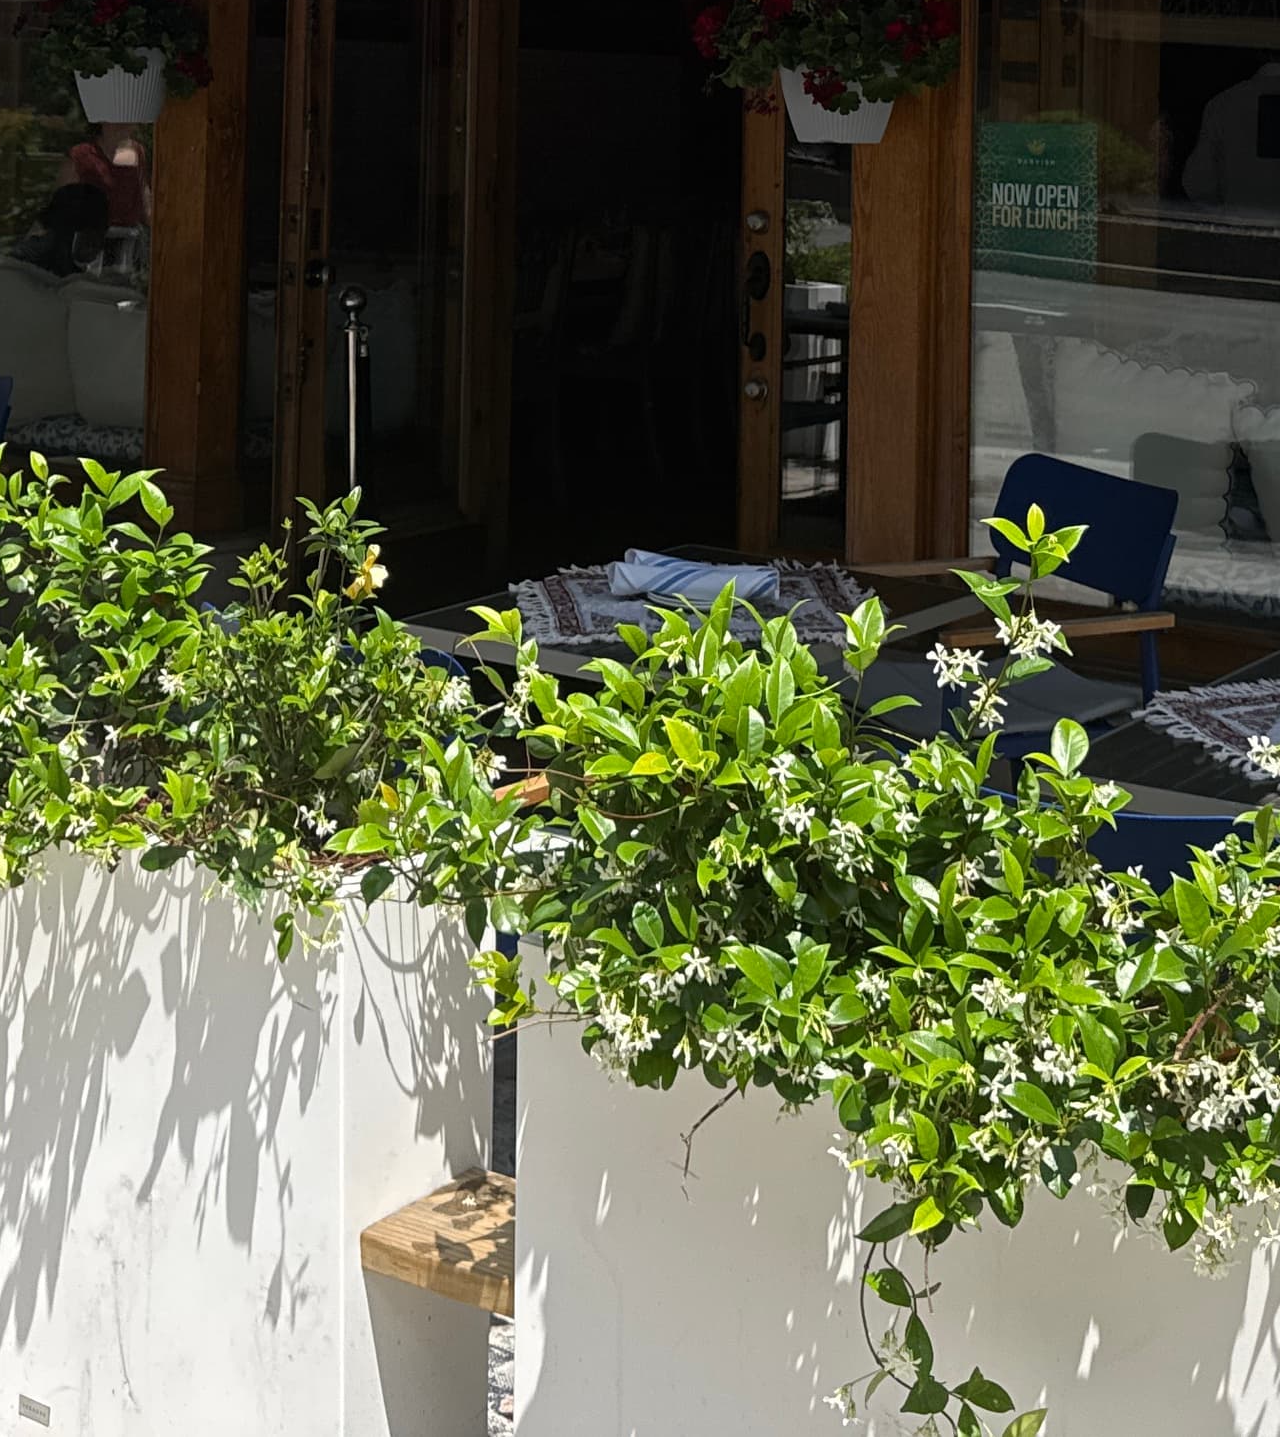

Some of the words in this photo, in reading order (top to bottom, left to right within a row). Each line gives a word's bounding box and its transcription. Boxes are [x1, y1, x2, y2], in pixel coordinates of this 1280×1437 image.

[991, 182, 1032, 207] NOW
[1035, 183, 1080, 209] OPEN
[991, 205, 1022, 228] FOR
[1026, 207, 1079, 231] LUNCH
